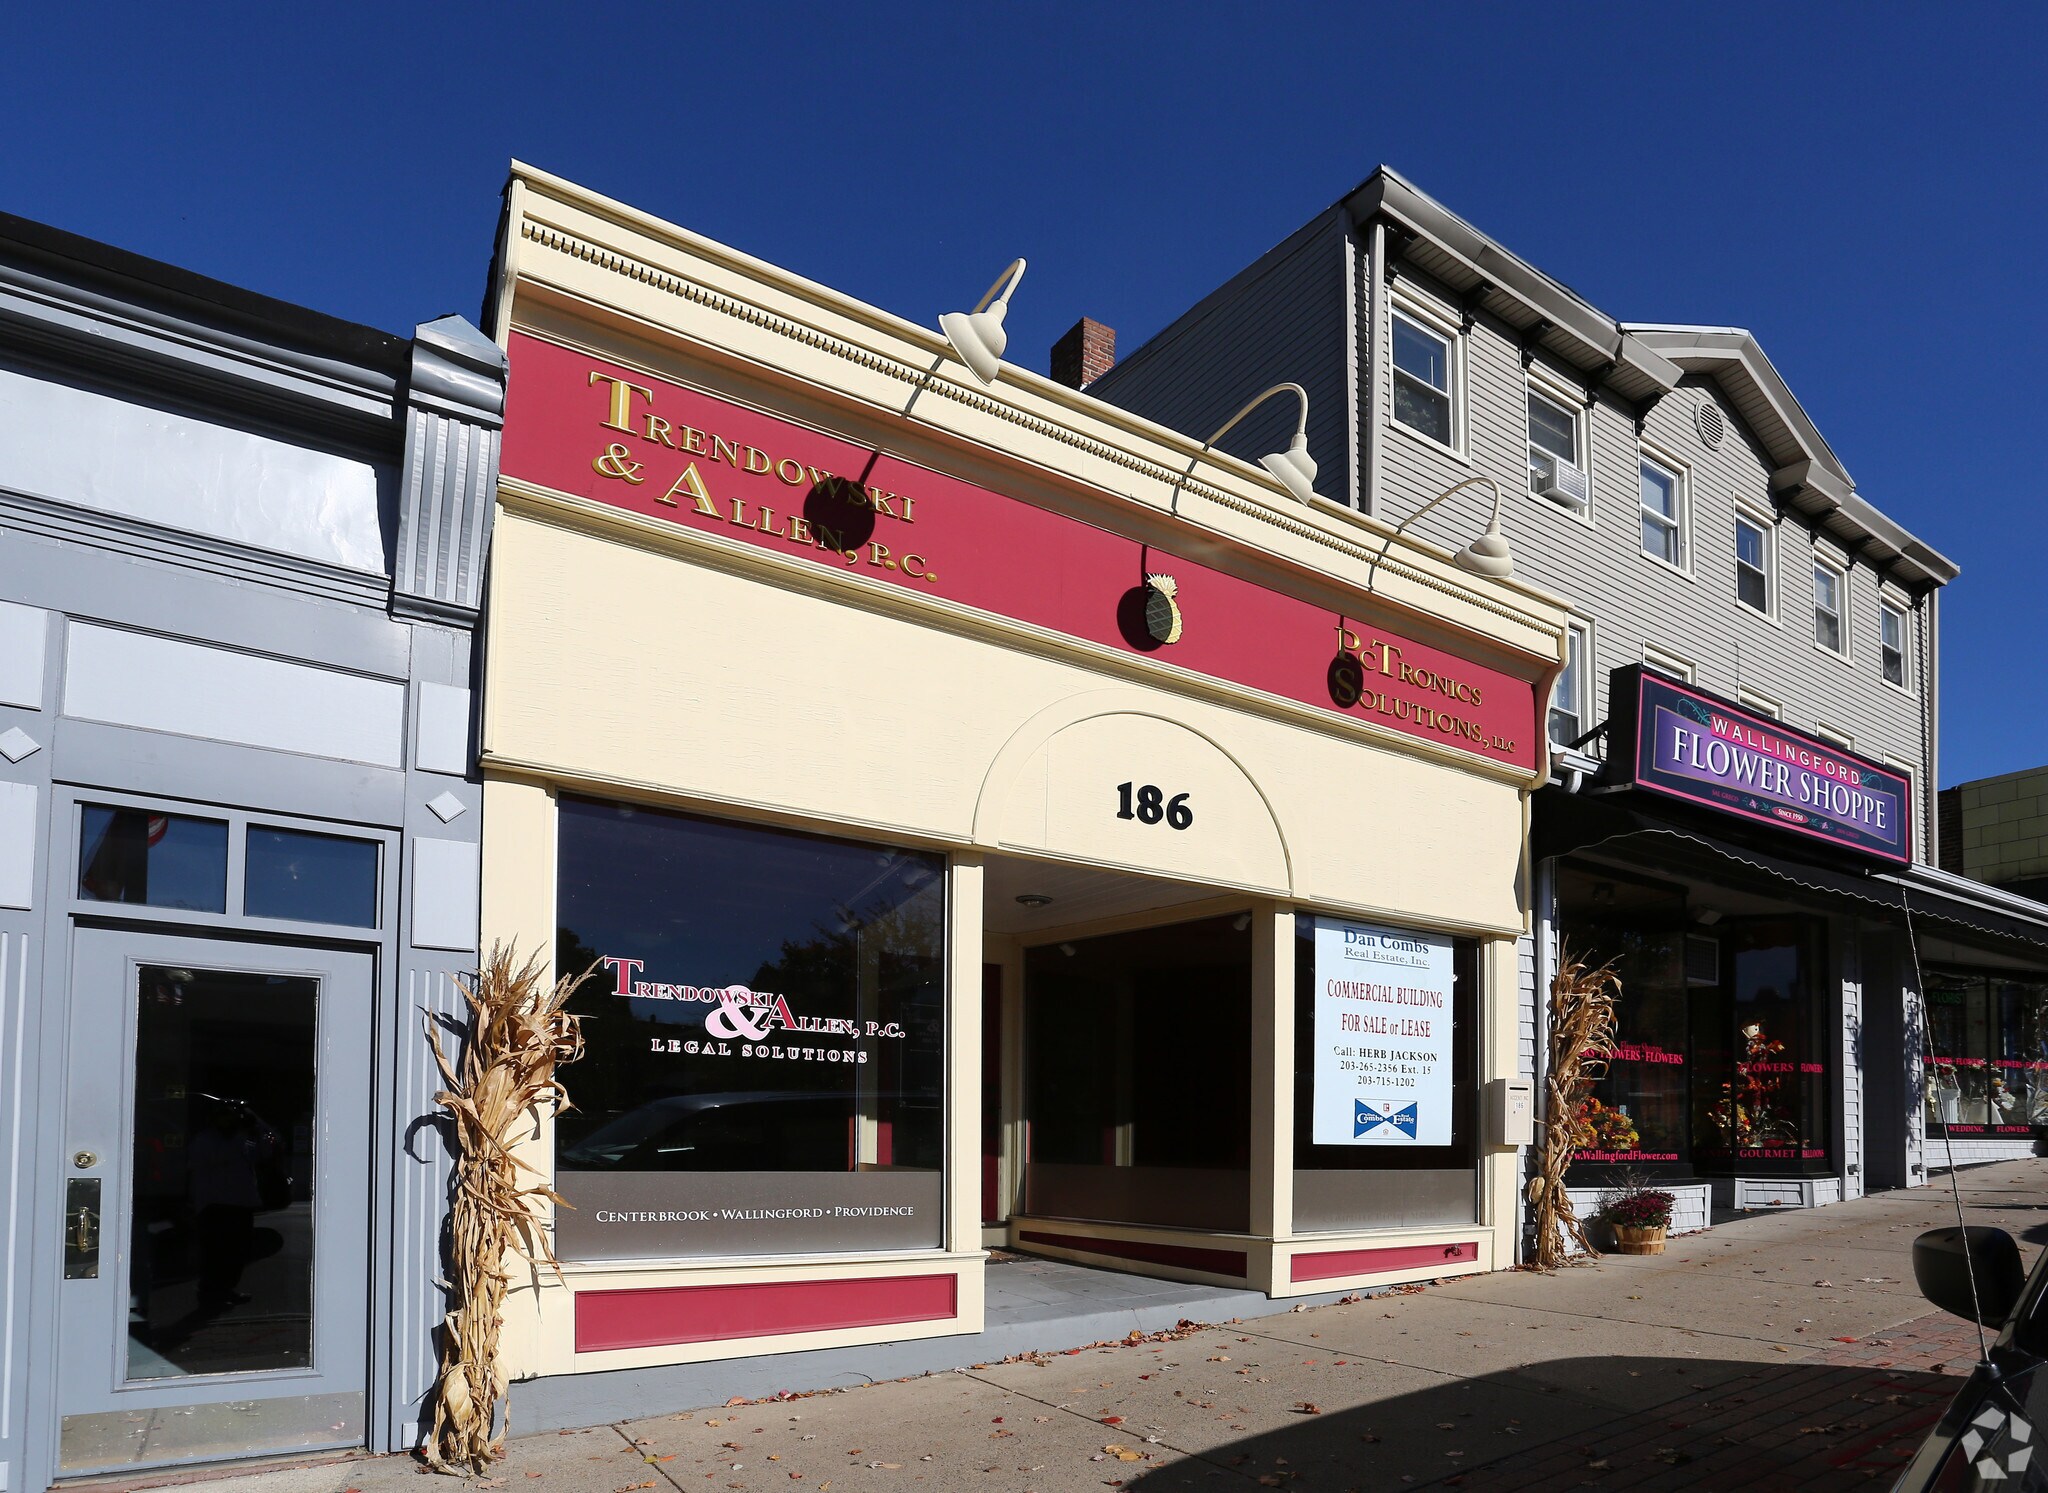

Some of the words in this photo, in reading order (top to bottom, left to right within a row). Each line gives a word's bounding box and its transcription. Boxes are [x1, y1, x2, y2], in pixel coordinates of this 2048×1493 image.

[588, 370, 916, 523] TRENDOWSKI
[592, 443, 645, 485] &
[655, 461, 858, 565] ALLEN,
[868, 541, 938, 582] P.C.
[1713, 716, 1860, 785] WALLINGFORD
[1672, 726, 1793, 798] FLOWER
[1800, 772, 1886, 829] SHOPPE
[1117, 781, 1193, 830] 186
[1778, 808, 1792, 818] SINCE
[1344, 929, 1375, 946] Dan
[1381, 935, 1429, 954] Combs
[1345, 947, 1369, 958] Real
[1373, 951, 1408, 964] Estate,
[1411, 956, 1430, 966] Inc.
[604, 957, 775, 1007] TRENDOWSKI
[1327, 979, 1393, 1003] COMMERCIAL
[1397, 987, 1443, 1008] BUILDING
[705, 985, 770, 1041] &
[759, 994, 860, 1038] ALLEN,
[866, 1021, 906, 1038] P.C.
[1342, 1013, 1360, 1032] FOR
[1364, 1015, 1387, 1034] SALE
[1390, 1024, 1399, 1035] or
[1401, 1019, 1431, 1037] LEASE
[651, 1038, 731, 1056] LEGAL
[742, 1044, 868, 1063] SOLUTIONS
[1334, 1046, 1356, 1057] Call:
[1359, 1048, 1387, 1059] HERB
[1390, 1050, 1437, 1062] JACKSON
[1645, 1052, 1684, 1065] FLOWERS
[1340, 1061, 1398, 1073] 203-265-2356
[1401, 1064, 1419, 1074] Ext.
[1422, 1066, 1431, 1075] 15
[1357, 1075, 1415, 1087] 203-715-1202
[1948, 1125, 1985, 1133] WEDDING
[1739, 1149, 1796, 1158] GOURMET
[596, 1210, 710, 1222] CENTERBROOK
[721, 1208, 823, 1220] WALLINGFORD
[835, 1206, 914, 1217] PROVIDENCE
